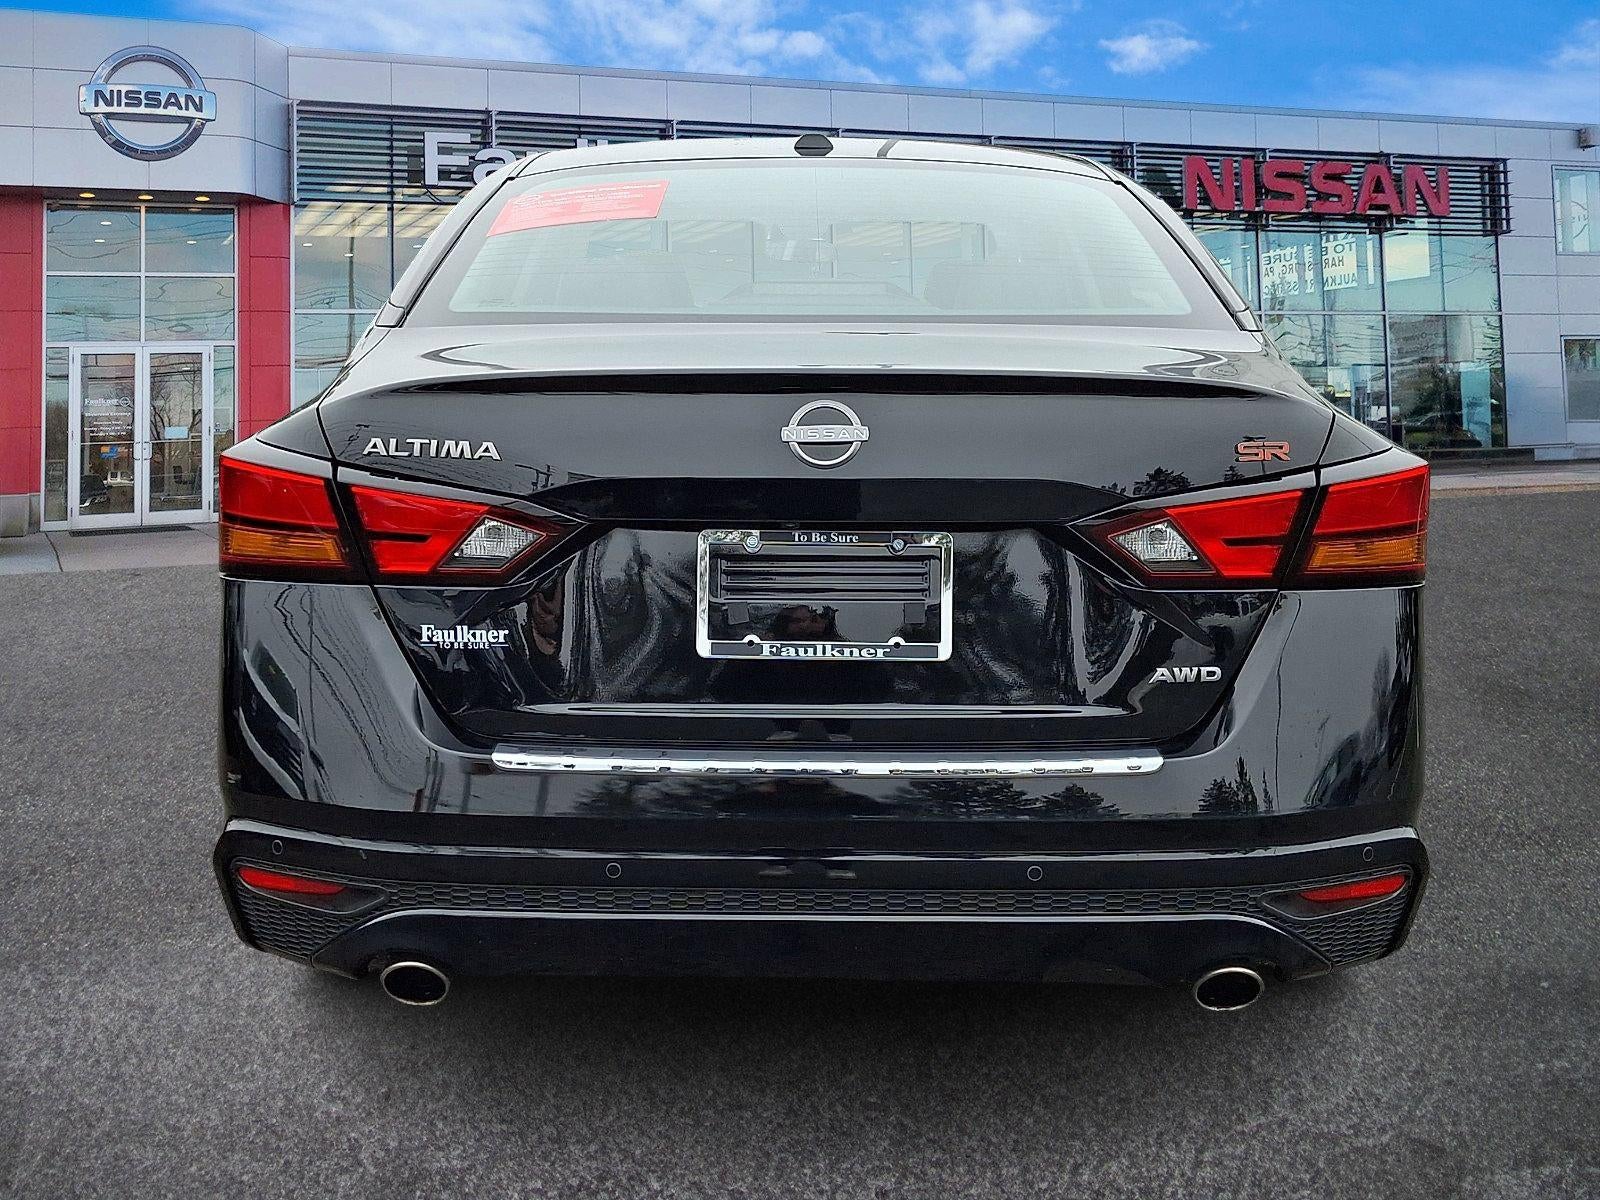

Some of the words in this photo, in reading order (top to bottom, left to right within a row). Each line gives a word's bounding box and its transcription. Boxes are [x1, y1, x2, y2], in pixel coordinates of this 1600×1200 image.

[93, 89, 204, 113] NISSAN
[1182, 155, 1451, 217] NISSAN
[784, 429, 867, 440] NISSAN
[362, 437, 502, 461] ALTIMA
[1236, 441, 1291, 462] SR
[792, 531, 807, 542] To
[811, 531, 827, 543] Be
[830, 532, 859, 543] Sure
[420, 624, 509, 643] Faulkner
[760, 643, 891, 658] Faulkner
[1148, 666, 1222, 684] AWD
